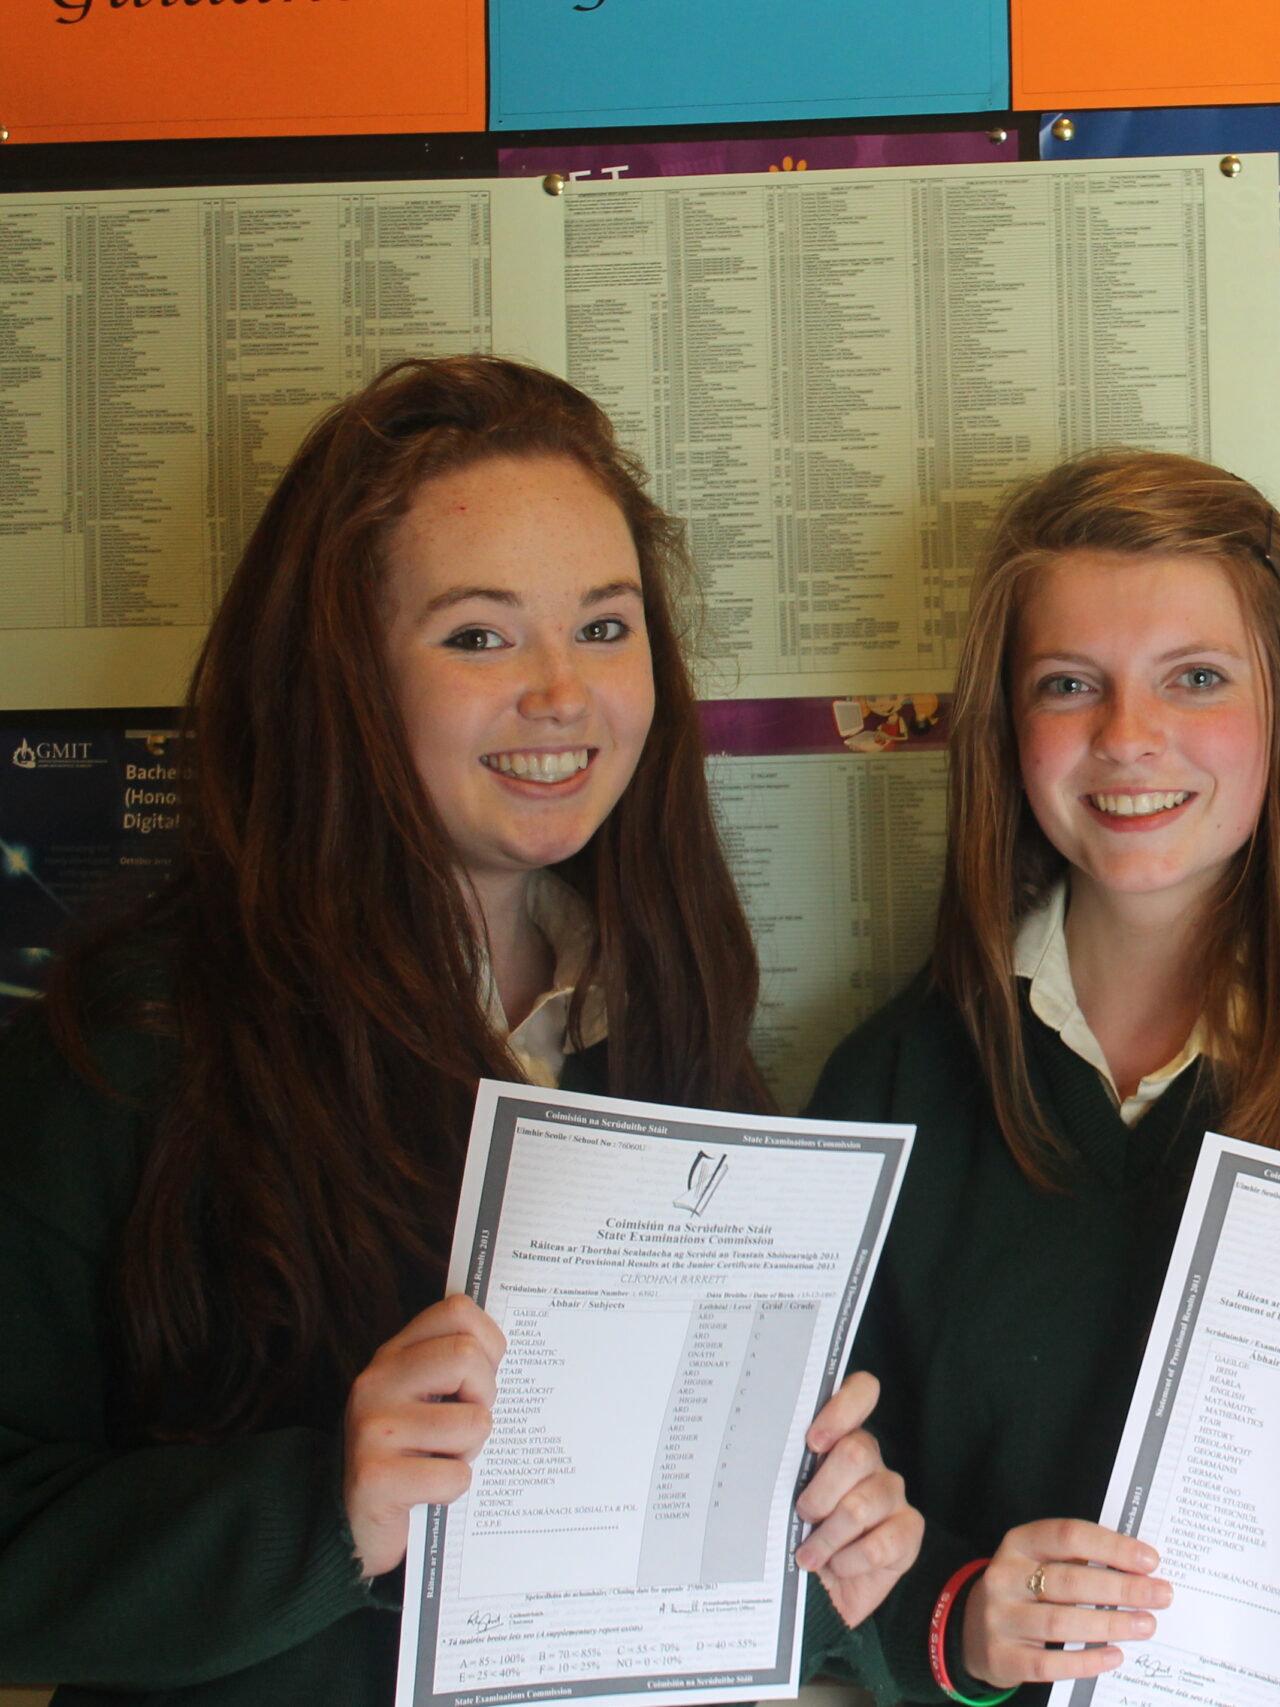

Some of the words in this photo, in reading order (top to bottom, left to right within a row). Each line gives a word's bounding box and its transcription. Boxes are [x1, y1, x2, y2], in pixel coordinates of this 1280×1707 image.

[37, 743, 92, 759] GMIT
[126, 764, 177, 780] Bache
[125, 788, 176, 808] (Hono
[123, 814, 180, 834] Digital
[648, 1125, 669, 1134] Stáit
[573, 1135, 599, 1145] School
[743, 1135, 763, 1144] State
[764, 1136, 816, 1147] Examinations
[817, 1140, 861, 1149] Commission
[606, 1217, 664, 1231] Coimisiún
[667, 1224, 681, 1232] na
[684, 1222, 744, 1234] Scrúduithe
[746, 1224, 772, 1234] Stáit
[596, 1229, 626, 1241] State
[629, 1231, 705, 1245] Examinations
[709, 1235, 774, 1245] Commission
[530, 1239, 565, 1251] Ráiteas
[622, 1248, 672, 1258] Sealadacha
[819, 1252, 839, 1260] 2013
[512, 1250, 561, 1263] Statement
[563, 1255, 573, 1264] of
[575, 1256, 625, 1267] Provisional
[627, 1259, 659, 1268] Results
[672, 1260, 684, 1269] the
[687, 1260, 714, 1269] Junior
[717, 1260, 761, 1269] Certificate
[763, 1261, 814, 1270] Examination
[817, 1261, 835, 1270] 2013
[680, 1274, 728, 1285] BARRETT
[553, 1288, 599, 1296] Examination
[601, 1289, 629, 1297] Number
[548, 1296, 580, 1308] Ábhair
[588, 1300, 625, 1310] Subjects
[789, 1302, 815, 1310] Grade
[1219, 1297, 1265, 1316] Statement
[1266, 1310, 1275, 1319] of
[515, 1319, 538, 1327] IRISH
[510, 1339, 546, 1347] ENGLISH
[506, 1357, 565, 1366] MATHEMATICS
[1249, 1350, 1280, 1367] Ábhair
[501, 1377, 535, 1385] HISTORY
[497, 1396, 546, 1405] GEOGRAPHY
[493, 1416, 527, 1425] GERMAN
[489, 1437, 528, 1445] BUSINESS
[529, 1436, 562, 1444] STUDIES
[486, 1457, 532, 1466] TECHNICAL
[533, 1456, 572, 1465] GRAPHICS
[482, 1478, 509, 1486] HOME
[510, 1477, 555, 1486] ECONOMICS
[479, 1499, 513, 1507] SCIENCE
[1183, 1486, 1220, 1504] BUSINESS
[1222, 1496, 1256, 1512] STUDIES
[455, 1696, 473, 1706] State
[475, 1691, 525, 1704] Examinations
[527, 1688, 572, 1698] Commission
